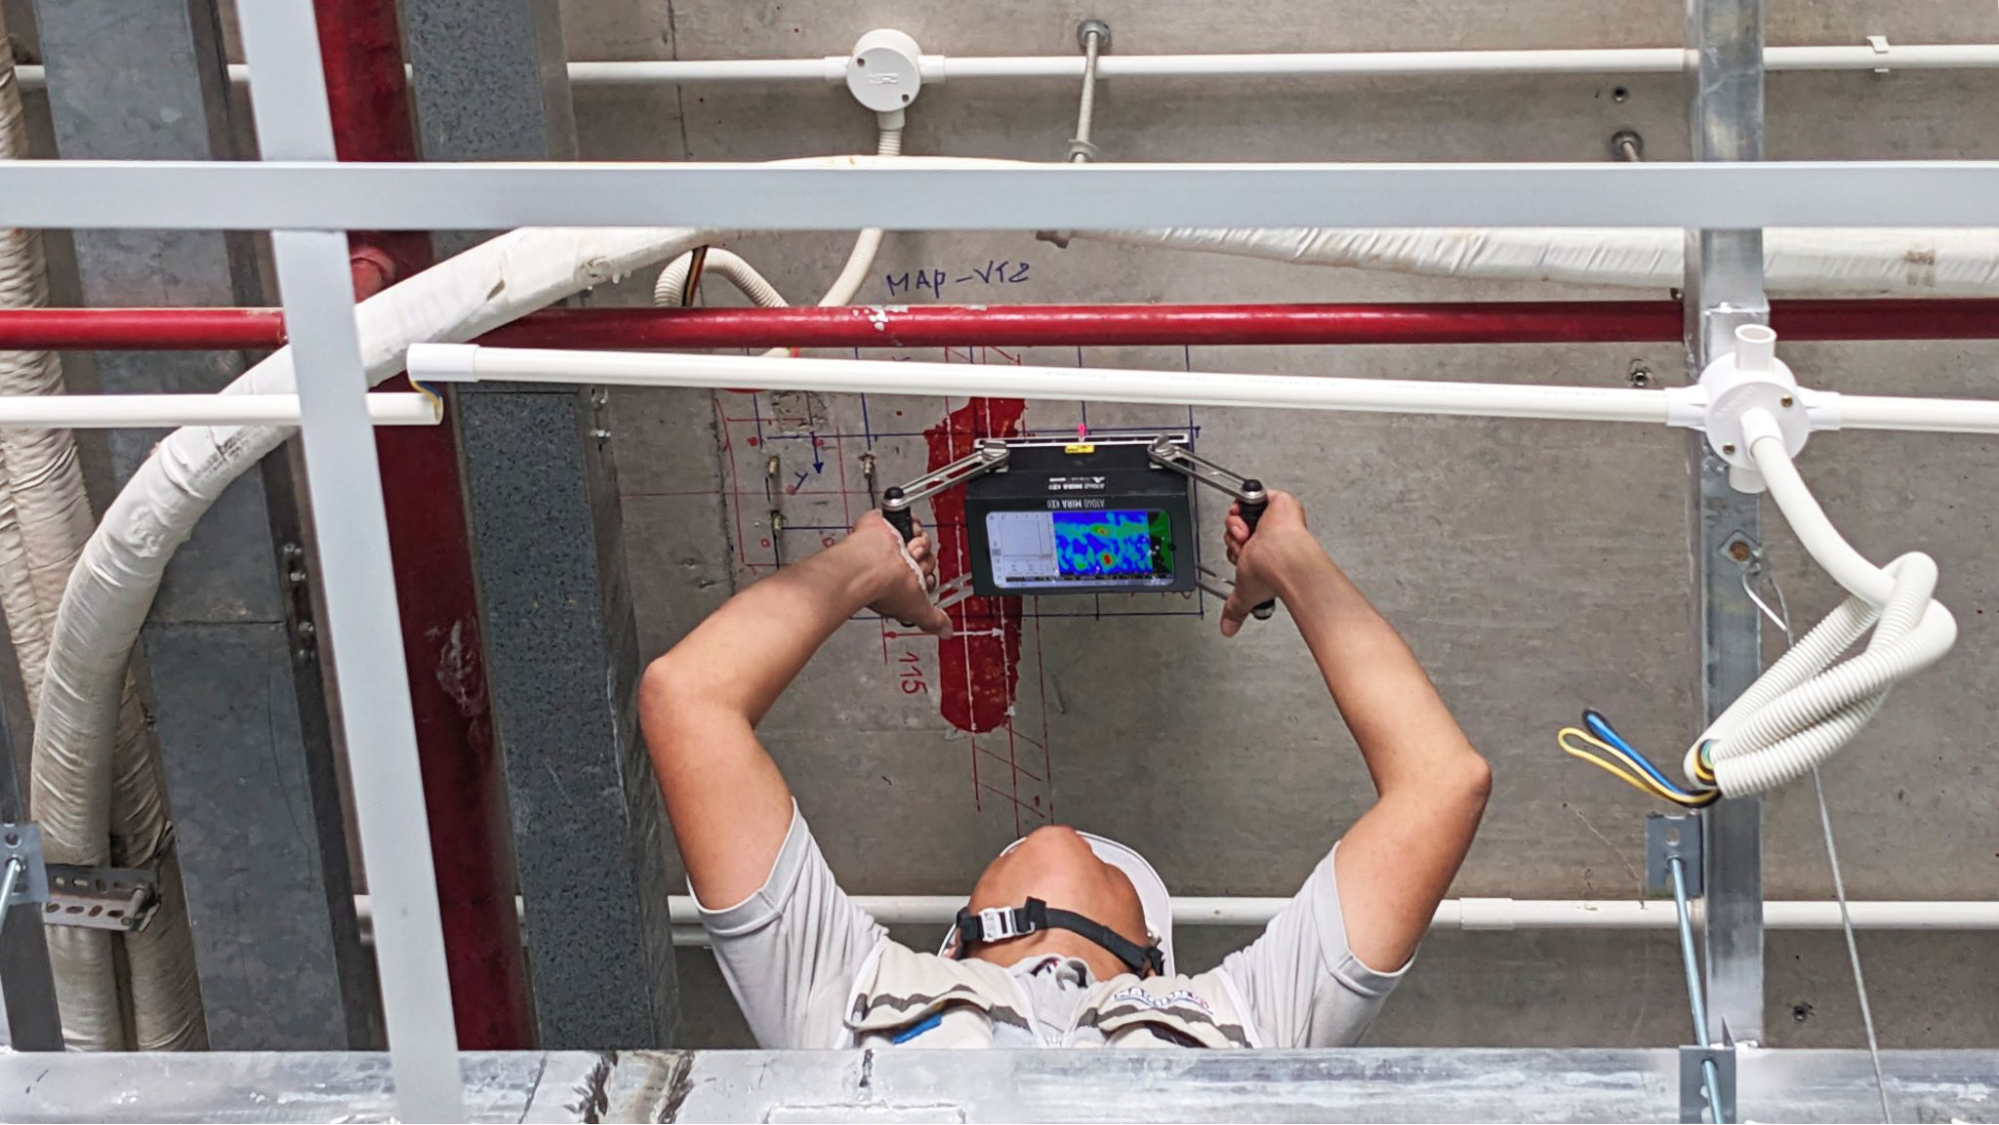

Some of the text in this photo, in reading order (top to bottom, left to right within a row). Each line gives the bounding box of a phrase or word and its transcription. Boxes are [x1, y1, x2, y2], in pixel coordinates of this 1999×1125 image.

[1061, 498, 1083, 509] MIRA
[1083, 498, 1105, 509] A1040
[899, 652, 928, 695] 115
